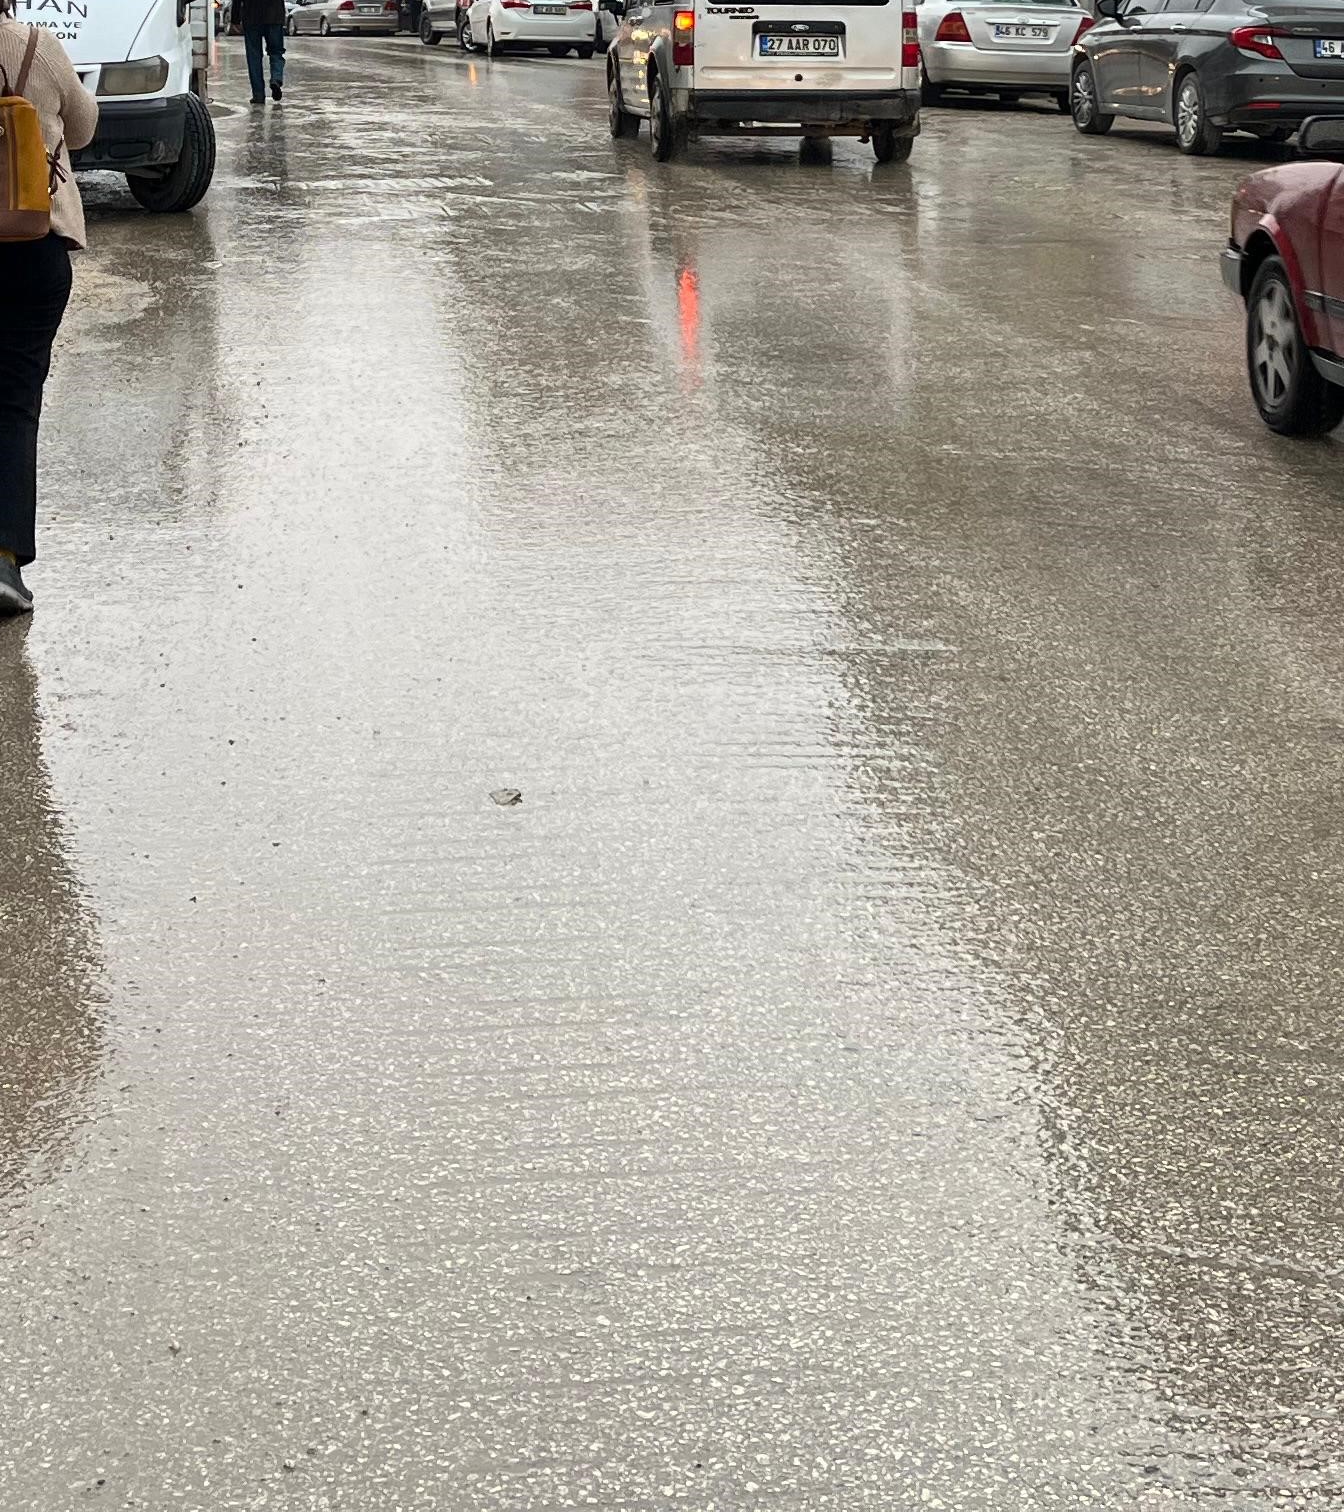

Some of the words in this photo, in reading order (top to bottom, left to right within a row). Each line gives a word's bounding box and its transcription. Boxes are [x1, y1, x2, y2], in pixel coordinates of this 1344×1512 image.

[705, 7, 755, 15] TOURNEO
[63, 21, 83, 29] VE
[768, 38, 784, 51] 27
[787, 38, 810, 51] AAR
[813, 38, 837, 51] 070
[1320, 40, 1336, 53] 46
